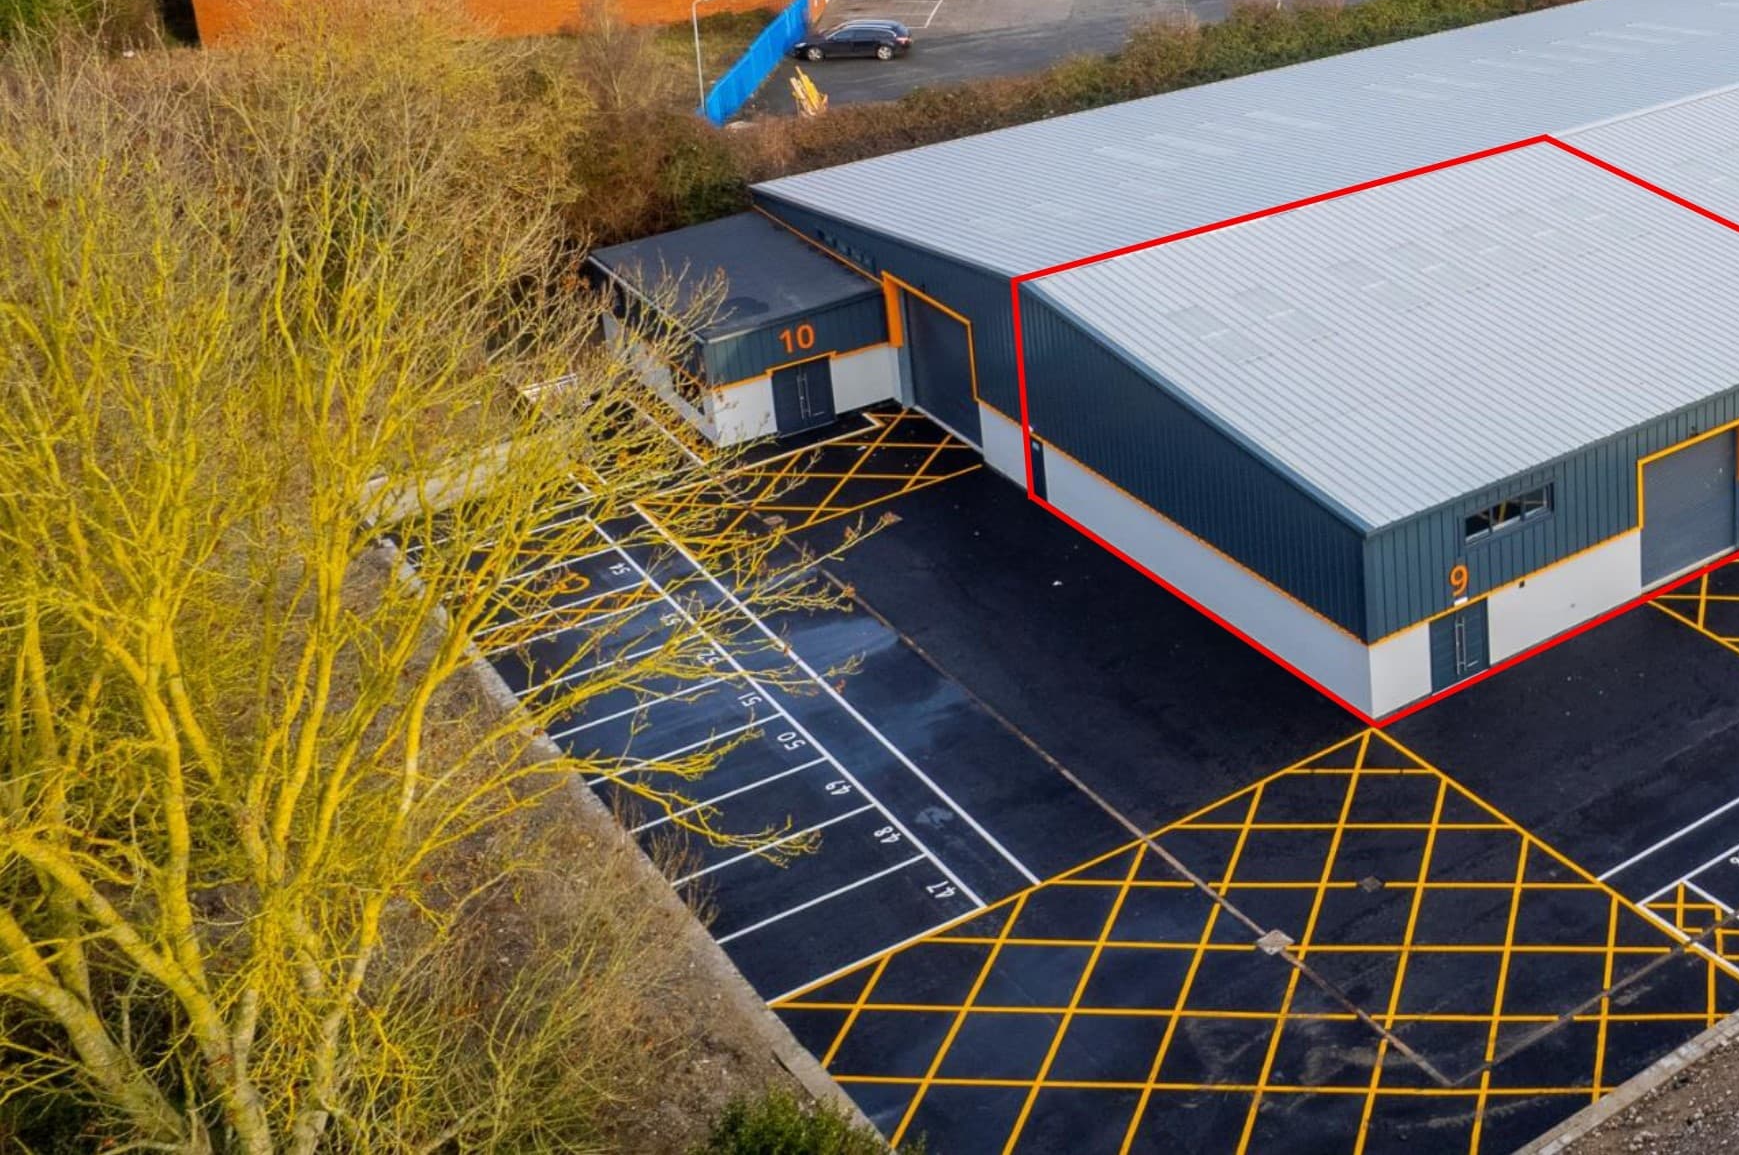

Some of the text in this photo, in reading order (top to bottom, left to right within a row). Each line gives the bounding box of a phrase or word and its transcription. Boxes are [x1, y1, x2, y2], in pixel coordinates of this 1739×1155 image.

[779, 324, 815, 352] 10
[1450, 565, 1468, 596] 9
[738, 692, 762, 707] 51
[777, 731, 806, 750] 50
[825, 780, 852, 795] 49
[873, 826, 901, 843] 48
[926, 881, 956, 898] 47
